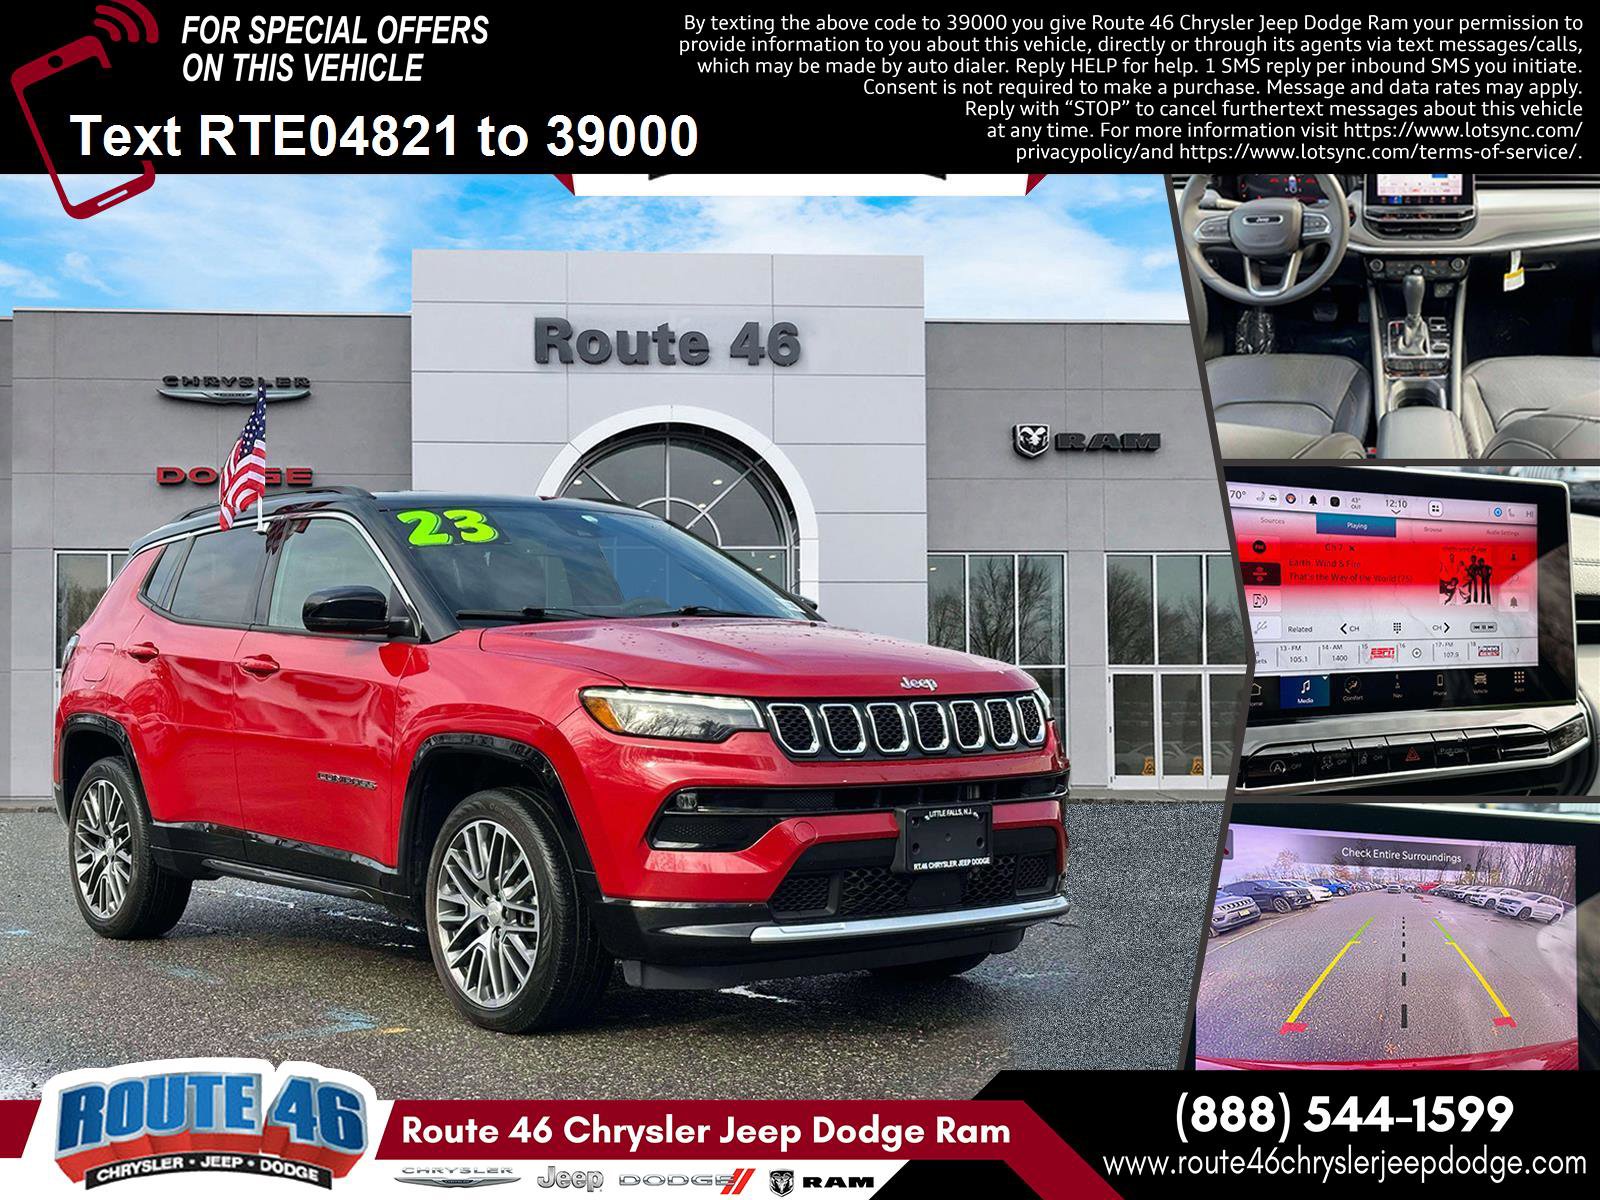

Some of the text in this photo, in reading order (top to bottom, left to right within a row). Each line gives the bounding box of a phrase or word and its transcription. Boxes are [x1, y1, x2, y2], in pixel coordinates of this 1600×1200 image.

[534, 317, 802, 367] Route 46
[162, 375, 310, 388] CHRYSLER
[1055, 432, 1161, 452] RAM
[1385, 499, 1408, 509] 12:10
[397, 509, 499, 546] 23
[1260, 516, 1285, 525] Sources
[900, 676, 938, 692] Jeep
[971, 857, 991, 866] DODGE
[1341, 847, 1462, 865] Check Entire Surroundings
